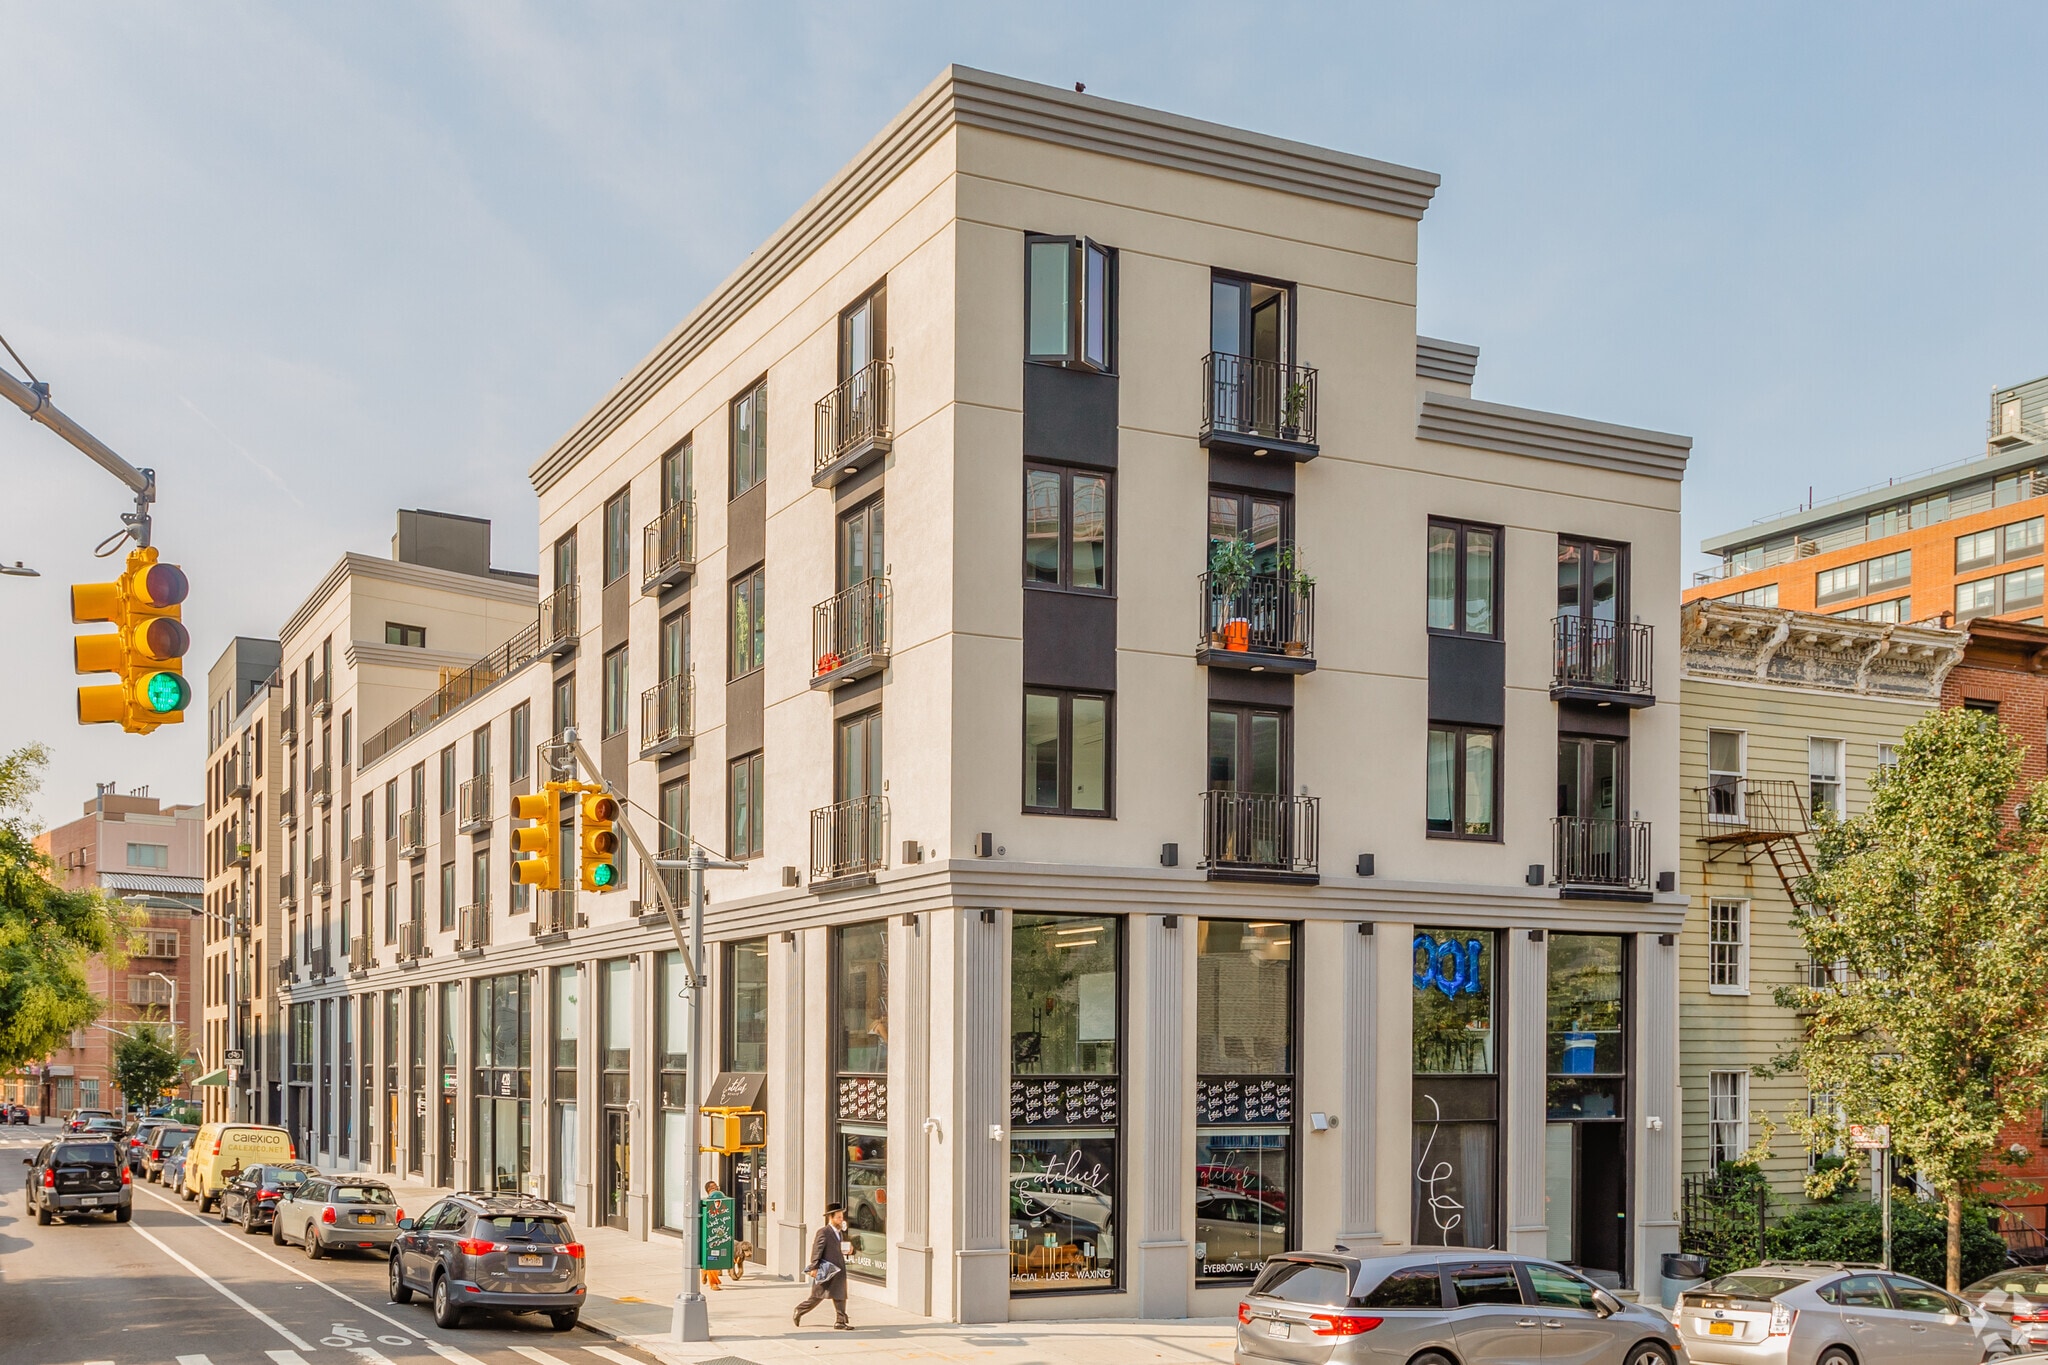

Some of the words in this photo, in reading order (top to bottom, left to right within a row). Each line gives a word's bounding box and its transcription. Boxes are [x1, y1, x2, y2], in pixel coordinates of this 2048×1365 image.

[232, 1133, 280, 1144] calexico
[228, 1144, 285, 1153] CALEXICO.NET
[1033, 1149, 1110, 1188] atelier
[1200, 1150, 1256, 1189] atelier
[1203, 1263, 1244, 1274] EYEBROWS
[1011, 1273, 1039, 1283] FACIAL
[1045, 1271, 1070, 1281] LASER
[1076, 1269, 1111, 1280] WAXING
